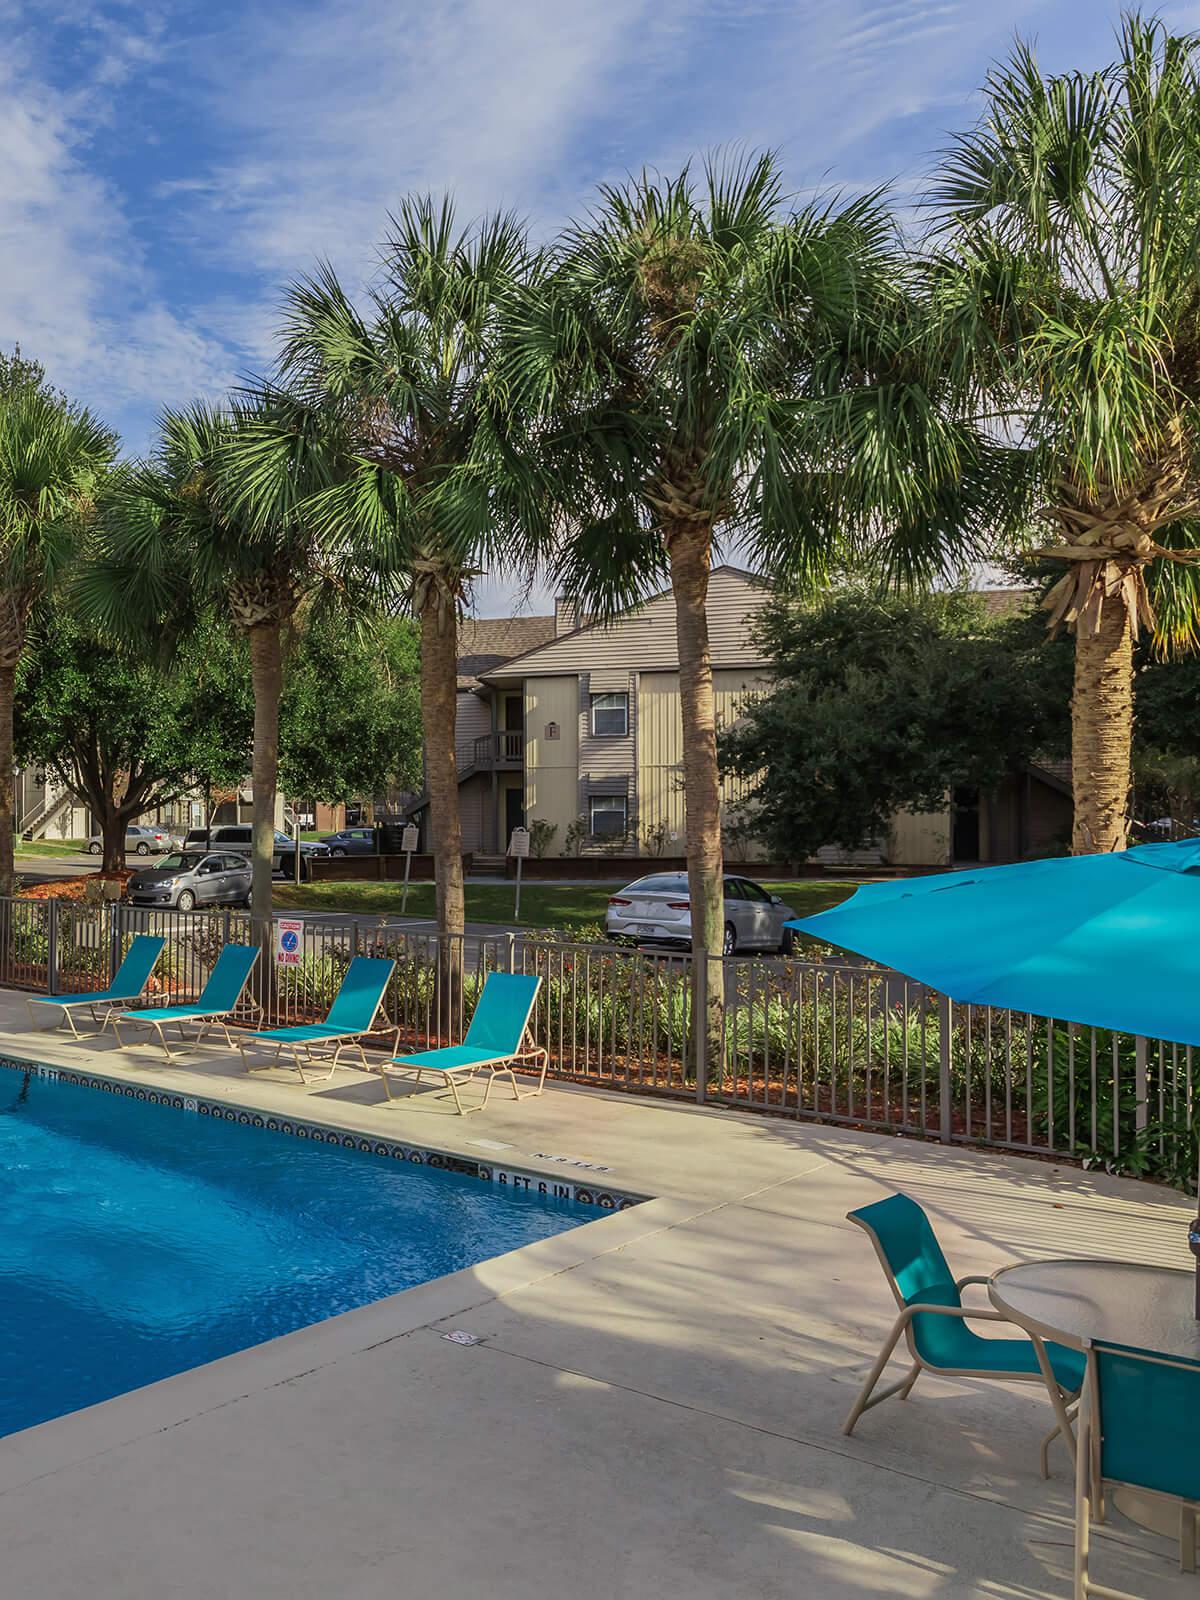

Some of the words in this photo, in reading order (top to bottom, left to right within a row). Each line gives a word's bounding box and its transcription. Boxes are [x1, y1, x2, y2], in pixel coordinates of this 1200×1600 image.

[48, 1070, 58, 1080] FT
[498, 1173, 507, 1184] 6
[513, 1176, 531, 1190] FT
[538, 1182, 547, 1194] 6
[554, 1184, 570, 1199] IN
